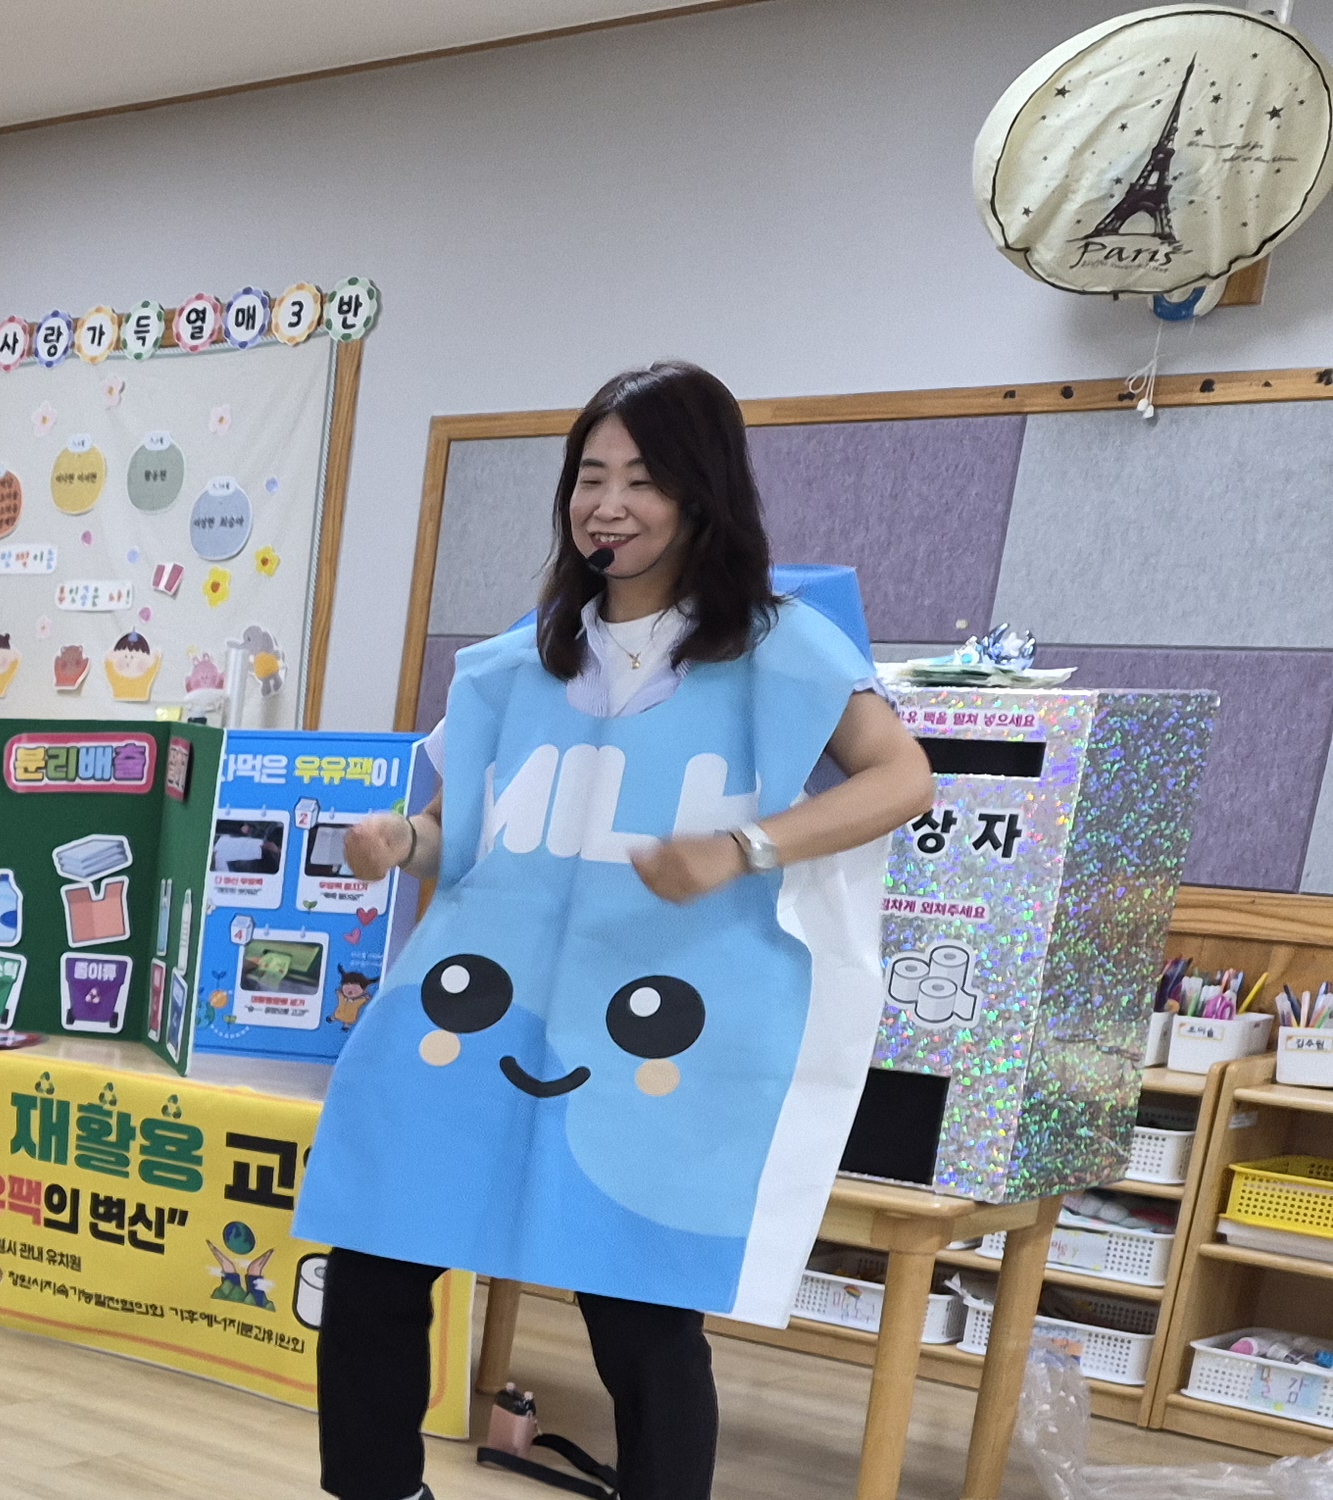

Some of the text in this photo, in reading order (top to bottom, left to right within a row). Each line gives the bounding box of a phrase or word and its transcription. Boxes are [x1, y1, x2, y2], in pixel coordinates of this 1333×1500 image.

[1070, 241, 1176, 269] Paris
[14, 742, 147, 782] 분리배출
[294, 755, 400, 787] 우유팩이
[297, 812, 309, 825] 2
[234, 929, 244, 940] 4
[73, 961, 117, 982] 종이류
[10, 1091, 205, 1193] 재활용
[224, 1131, 312, 1211] 교
[45, 1247, 82, 1272] 유치원
